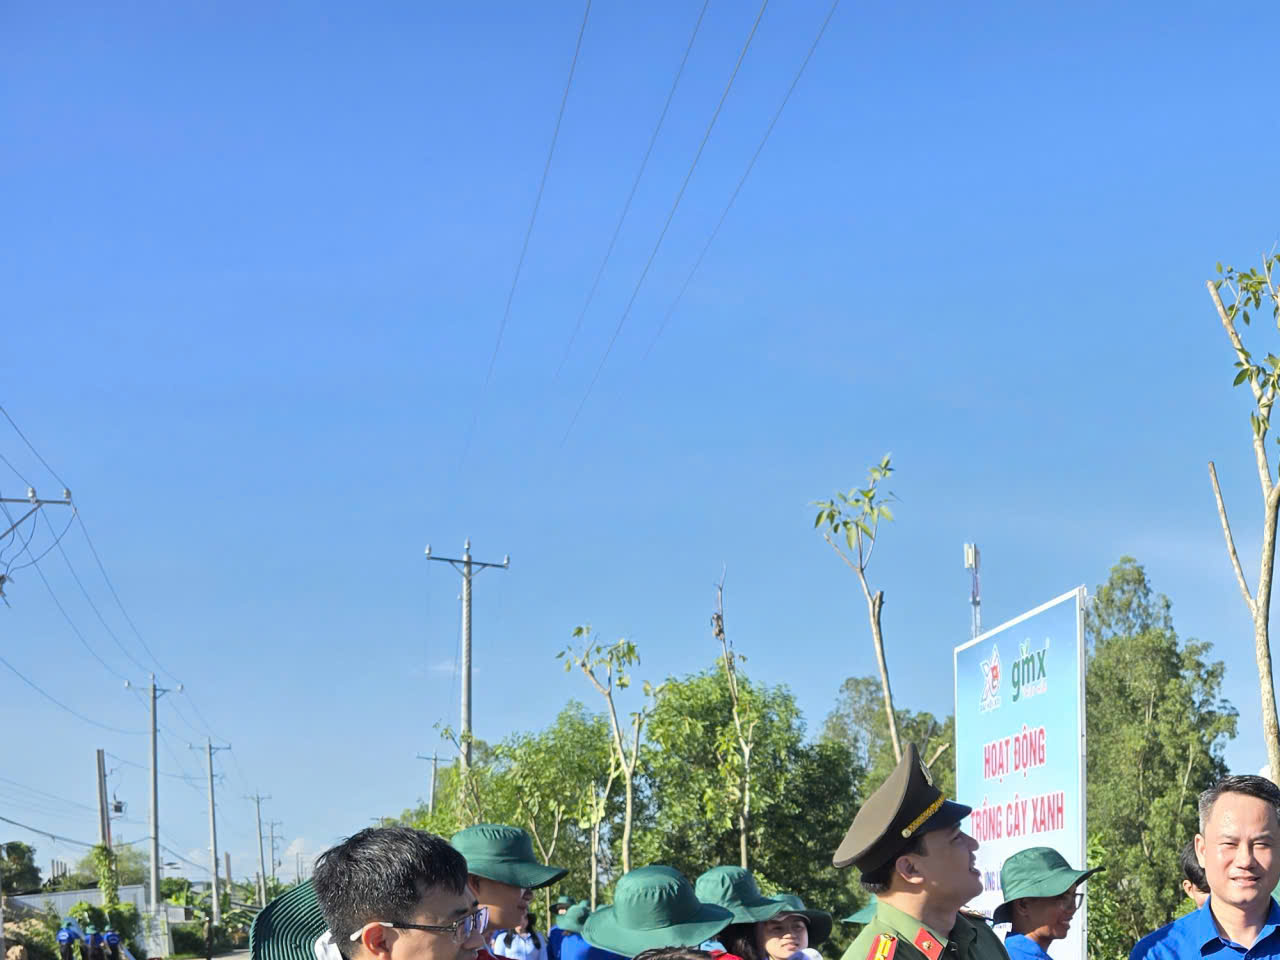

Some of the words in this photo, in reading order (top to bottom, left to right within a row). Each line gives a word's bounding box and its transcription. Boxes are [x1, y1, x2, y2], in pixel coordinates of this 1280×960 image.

[984, 738, 1010, 783] HOẠT
[1013, 725, 1045, 778] ĐỘNG
[1006, 793, 1028, 838] CÂY
[1031, 791, 1064, 834] XANH
